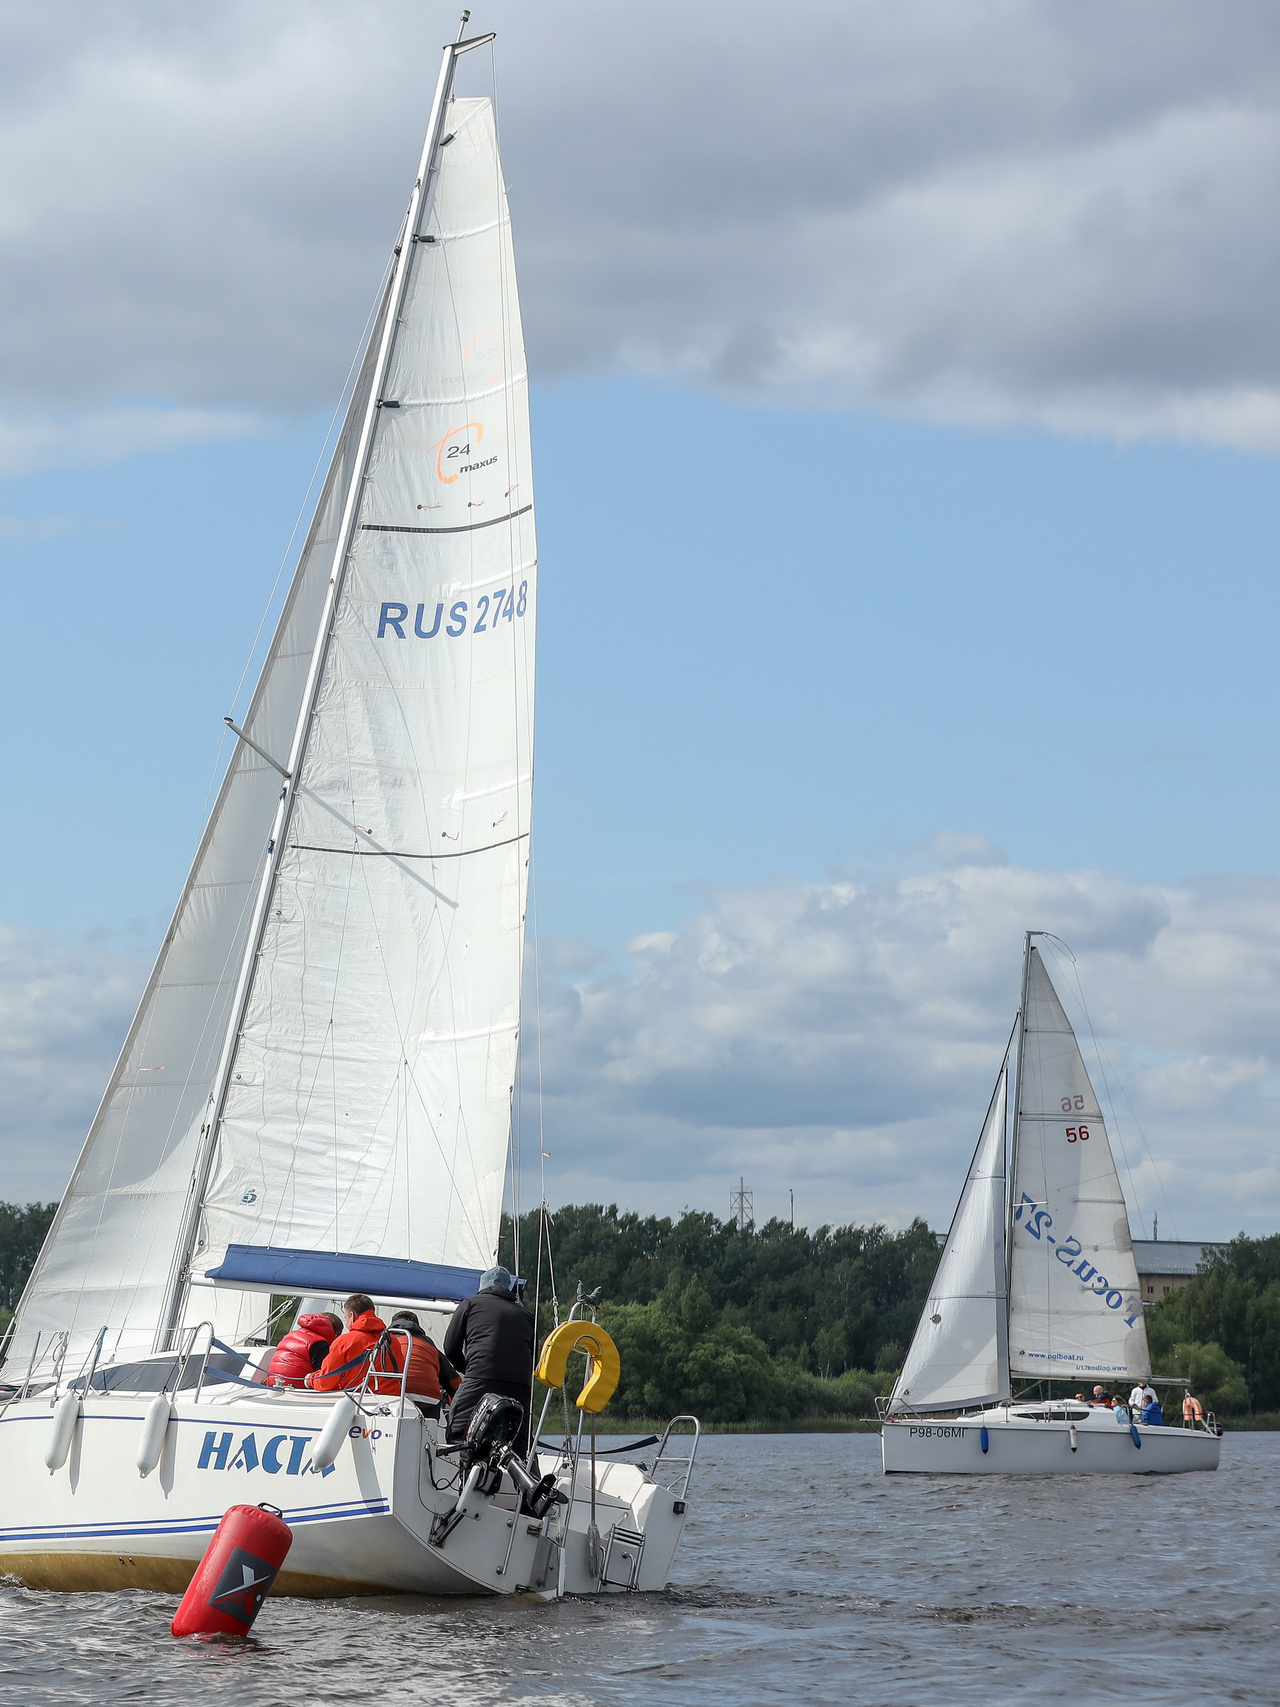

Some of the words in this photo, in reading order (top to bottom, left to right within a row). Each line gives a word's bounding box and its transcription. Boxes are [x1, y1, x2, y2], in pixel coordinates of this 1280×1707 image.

[447, 443, 471, 459] 24
[460, 456, 498, 473] maxus
[1065, 1125, 1090, 1143] 56
[1027, 1351, 1084, 1361] www.polboat.ru
[348, 1425, 382, 1440] evo
